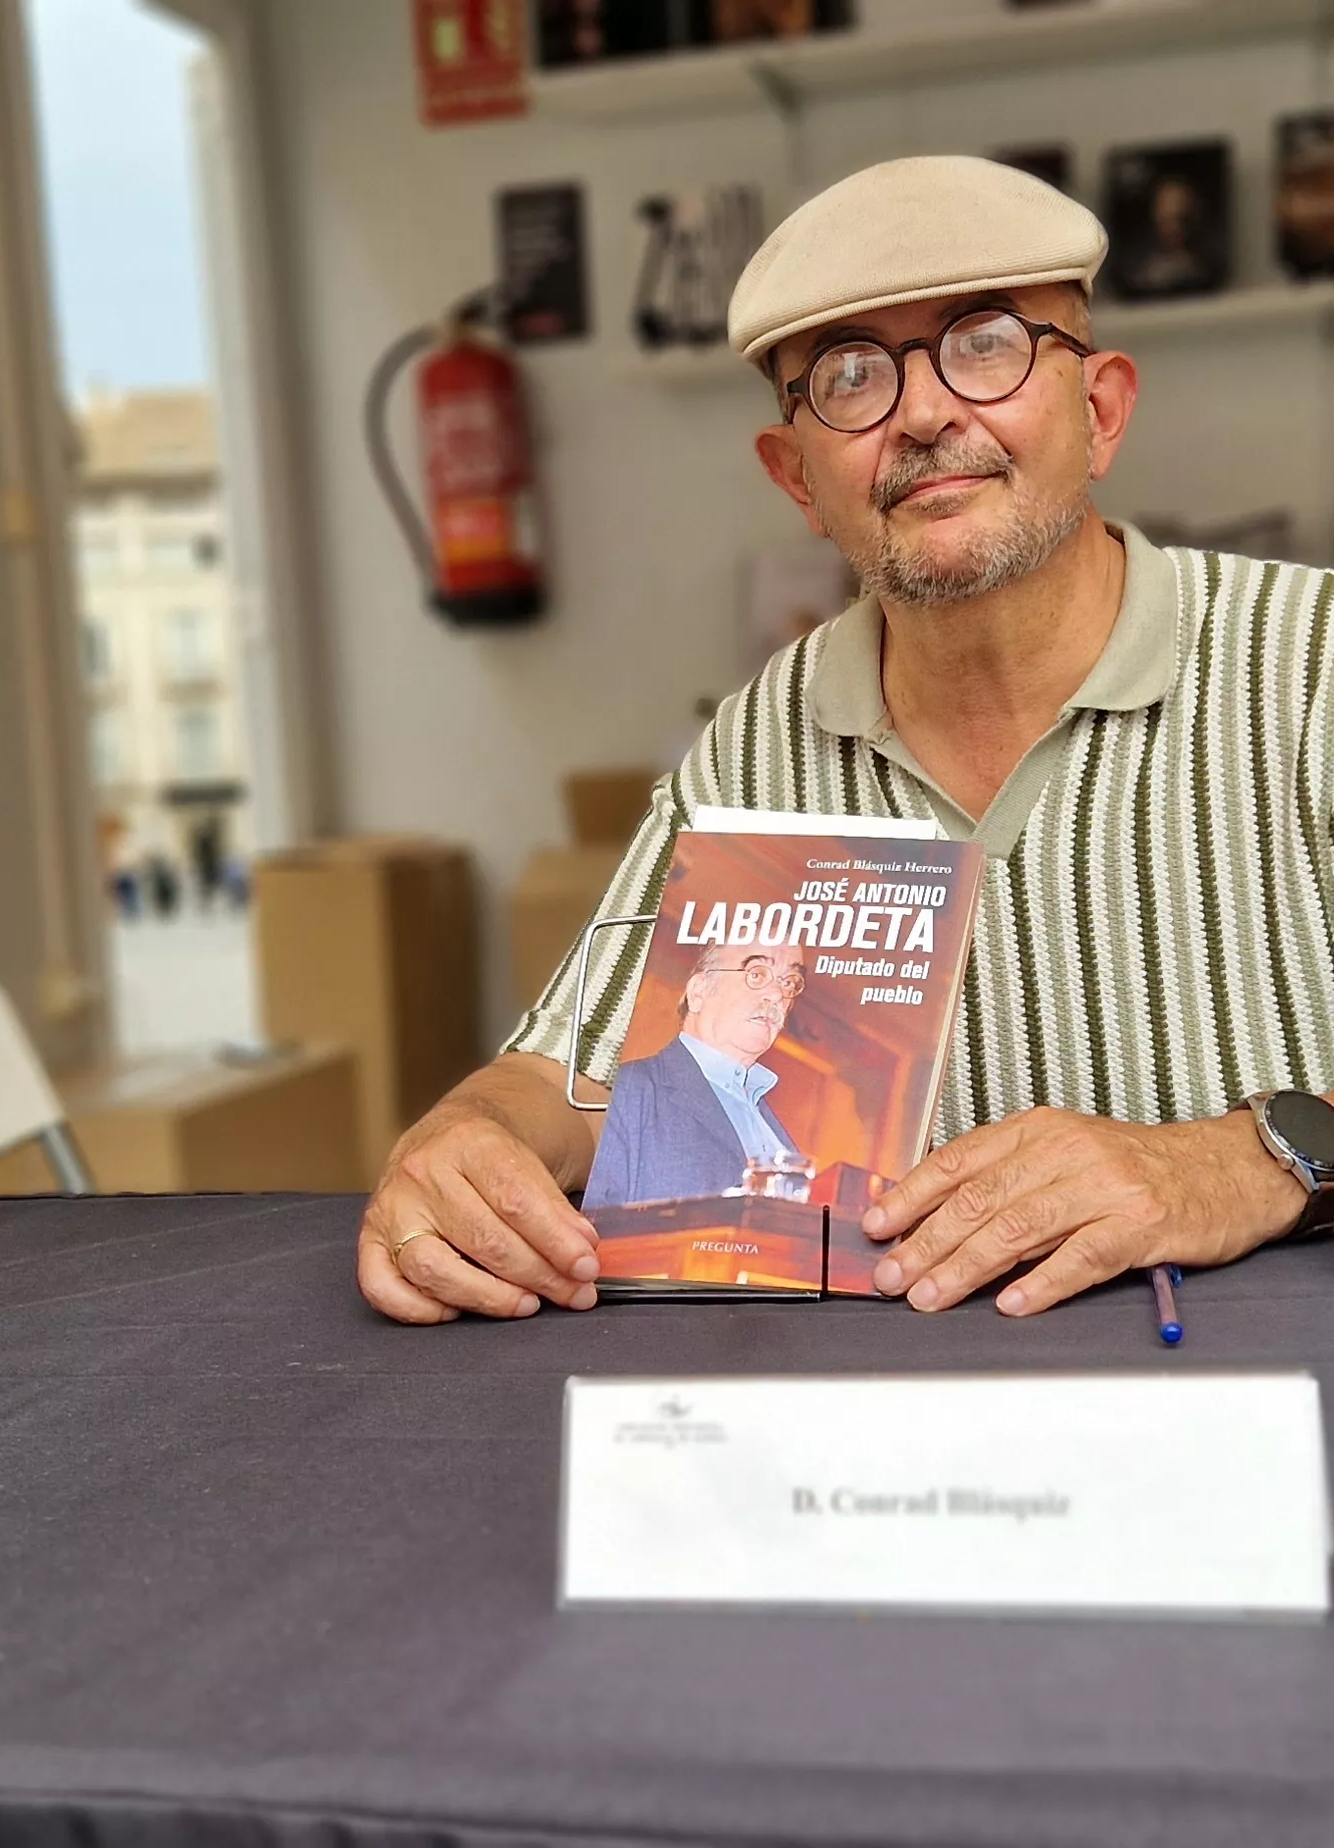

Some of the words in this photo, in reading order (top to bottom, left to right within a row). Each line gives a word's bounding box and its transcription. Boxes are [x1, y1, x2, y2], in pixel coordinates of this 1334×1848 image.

[806, 858, 850, 870] Conrad
[904, 861, 953, 875] Herrero
[793, 877, 849, 902] JOSÉ
[852, 882, 947, 907] ANTONIO
[676, 900, 935, 953] LABORDETA
[815, 955, 894, 978] Diputado
[900, 960, 930, 980] del
[860, 984, 924, 1006] pueblo
[692, 1241, 759, 1255] PREGUNTA
